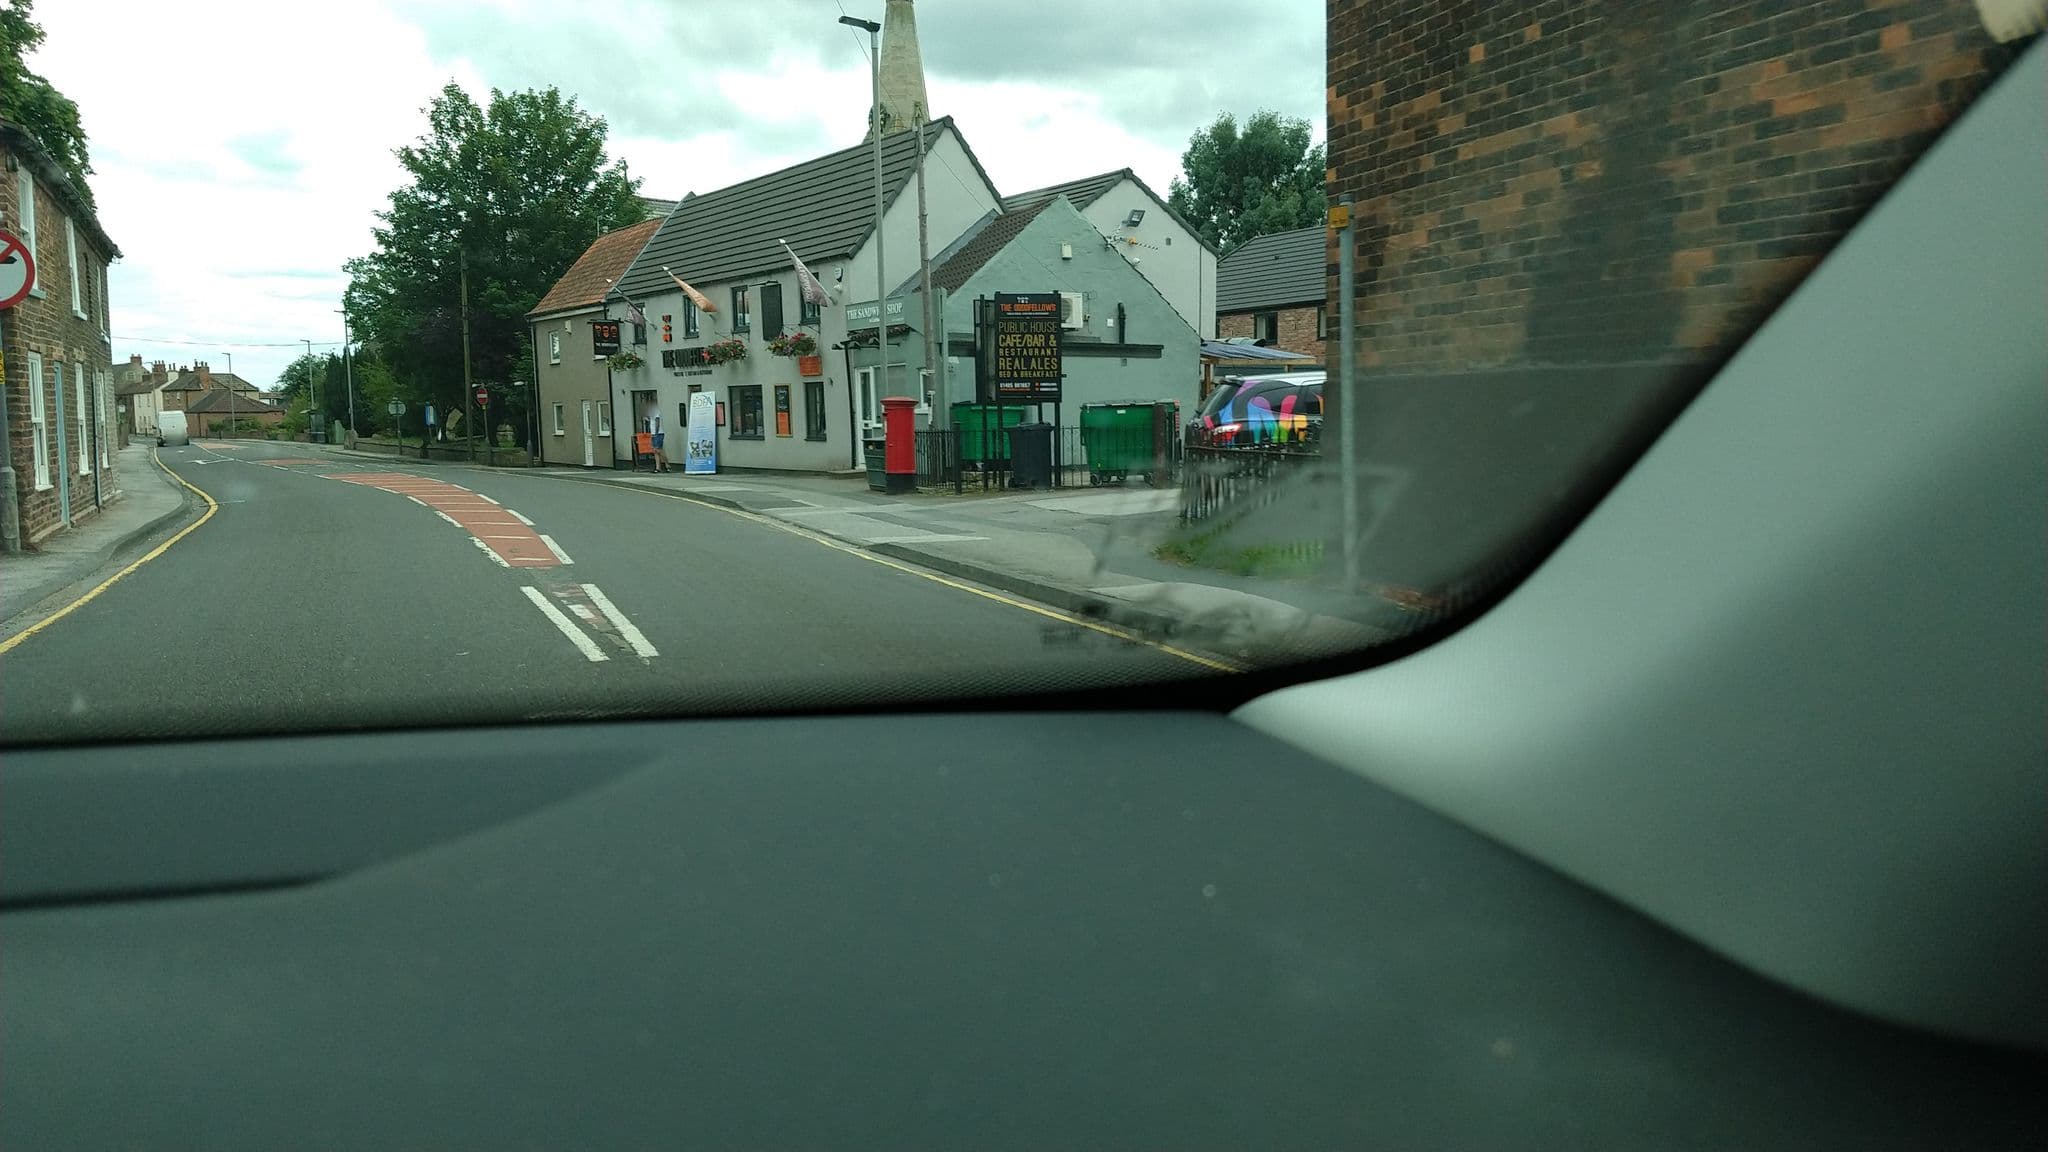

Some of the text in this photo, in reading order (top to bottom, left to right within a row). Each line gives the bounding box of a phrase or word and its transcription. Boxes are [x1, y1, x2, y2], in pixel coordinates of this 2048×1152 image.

[887, 303, 903, 315] SHOP
[1000, 304, 1013, 312] THE
[999, 321, 1058, 333] PUBLIC HOUSE
[999, 334, 1057, 347] CAFE/BAR &
[999, 348, 1058, 356] RESTAURANT
[999, 357, 1058, 370] REAL ALES
